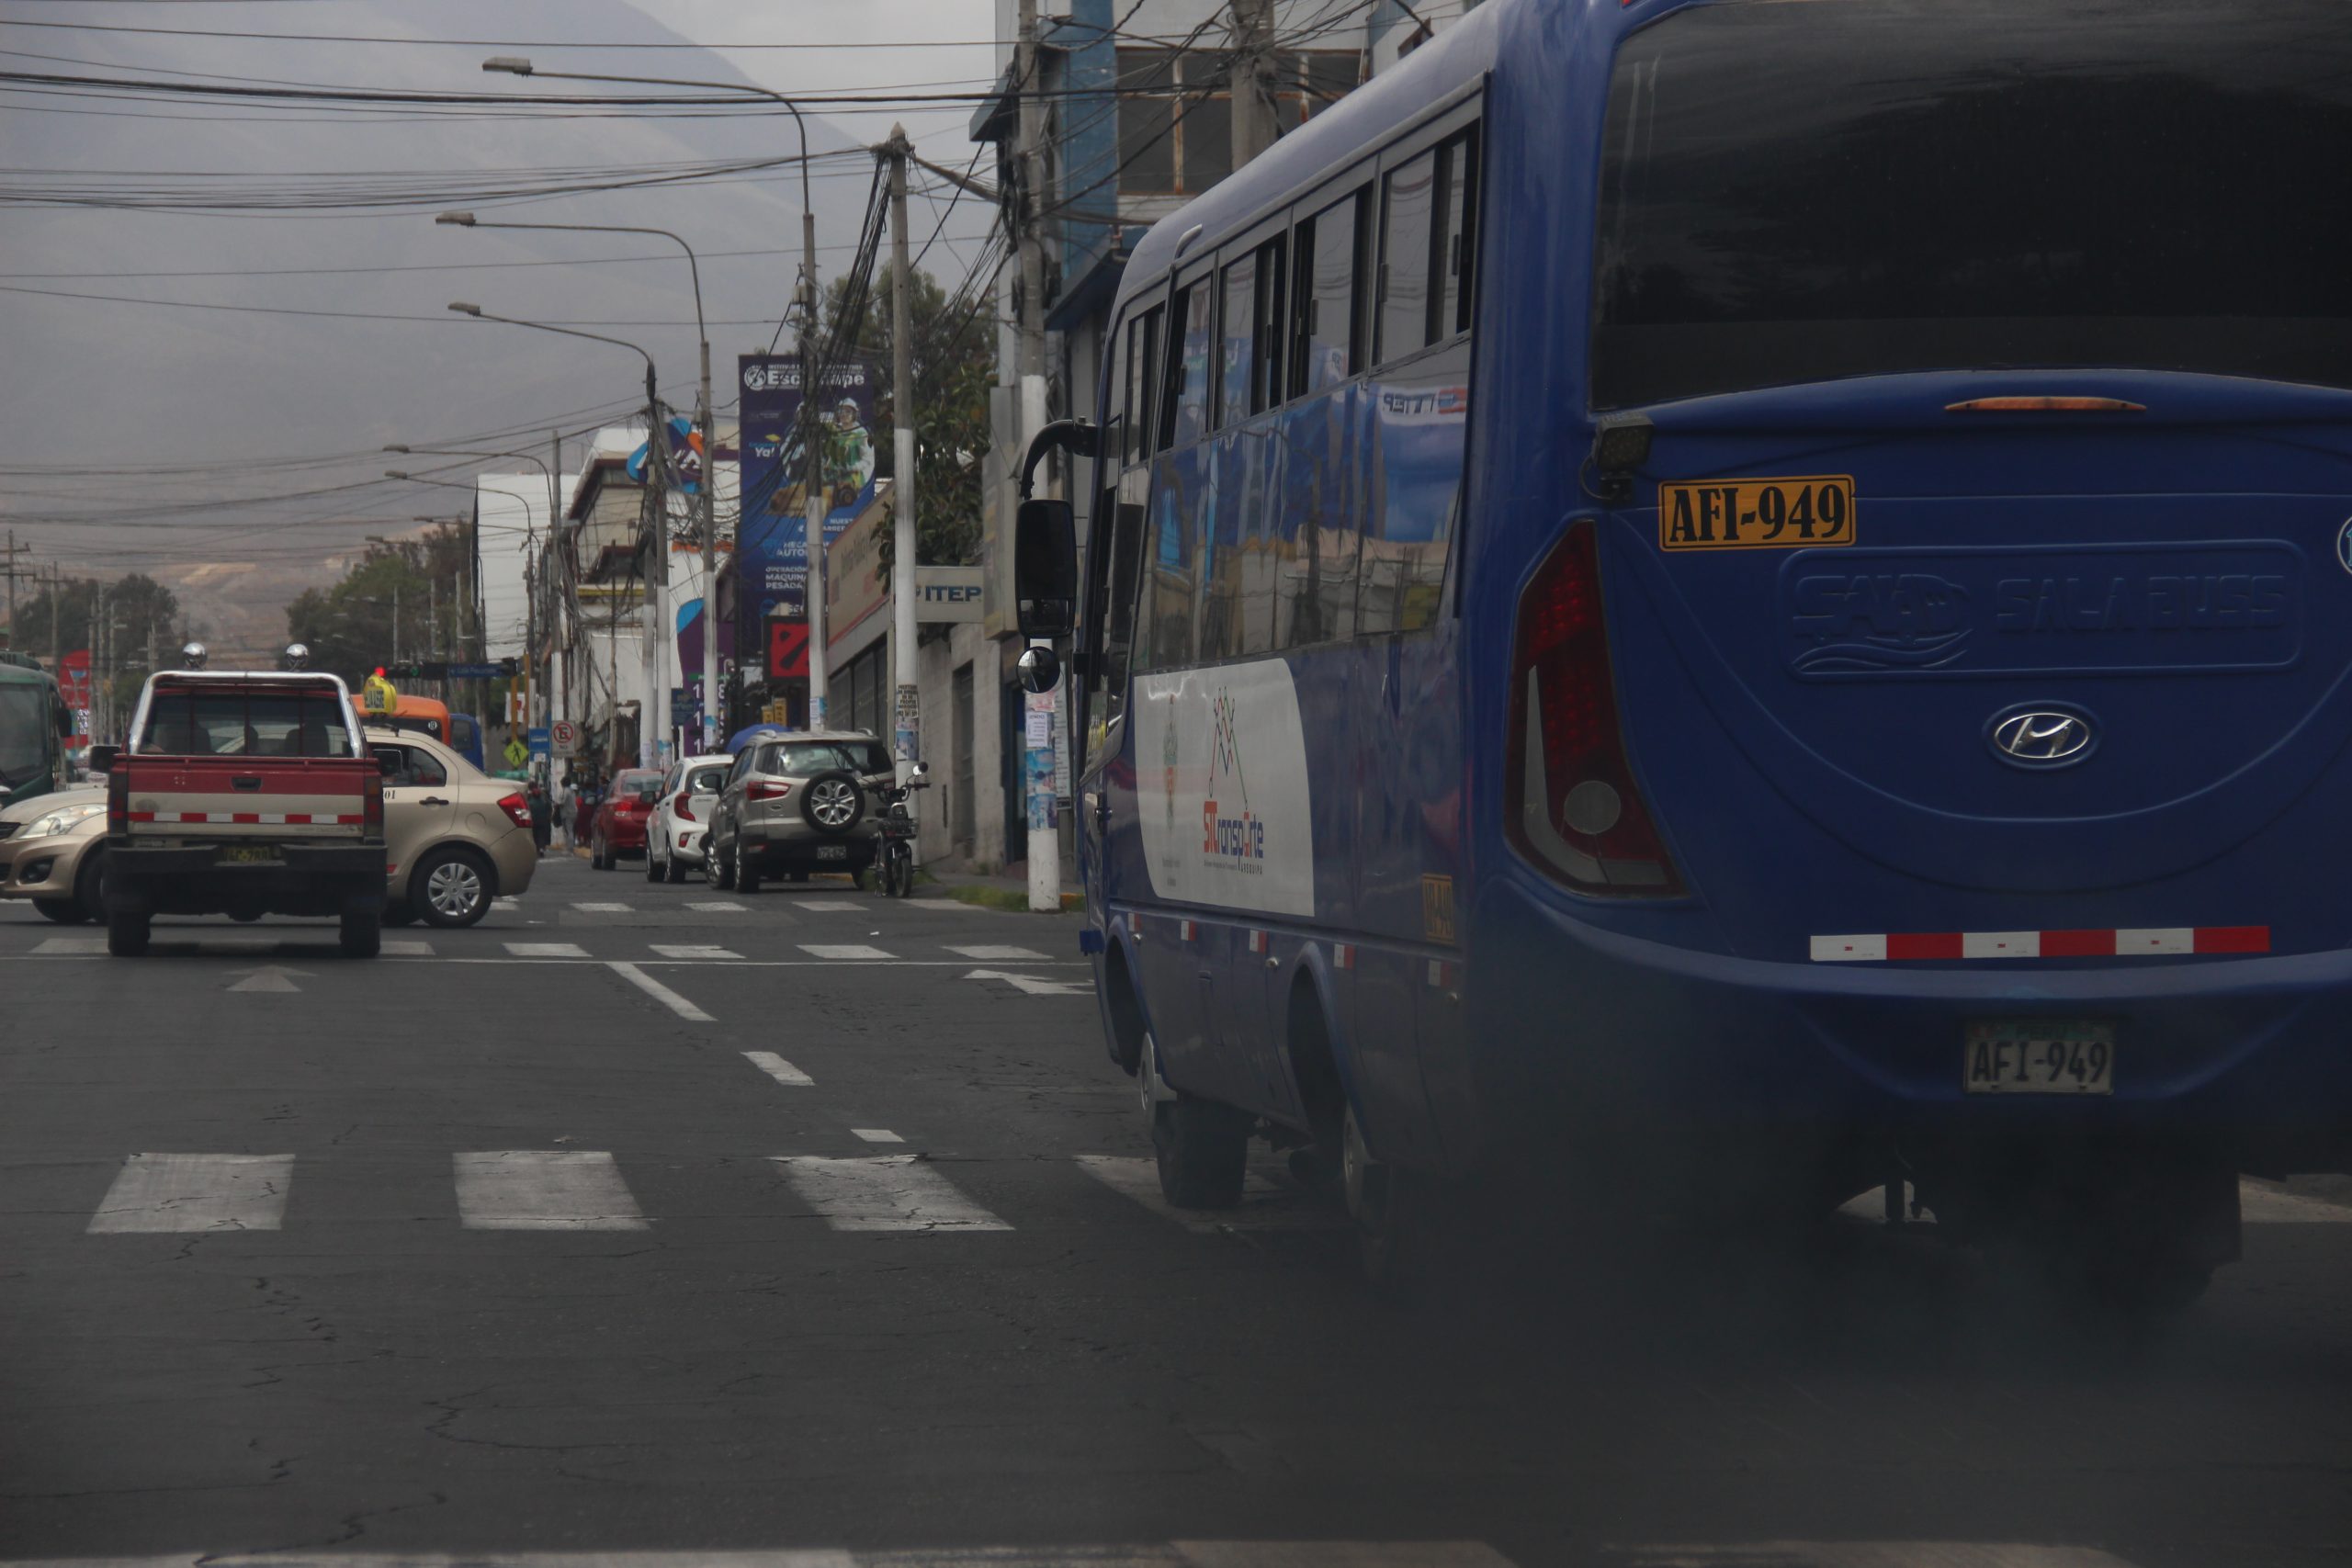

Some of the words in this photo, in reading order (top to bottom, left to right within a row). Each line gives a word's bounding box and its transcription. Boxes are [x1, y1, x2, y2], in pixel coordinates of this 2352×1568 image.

[755, 447, 775, 458] Ya!
[1669, 484, 1846, 542] AFI-949
[925, 586, 982, 602] ITEP
[1972, 1042, 2108, 1083] AFI-949
